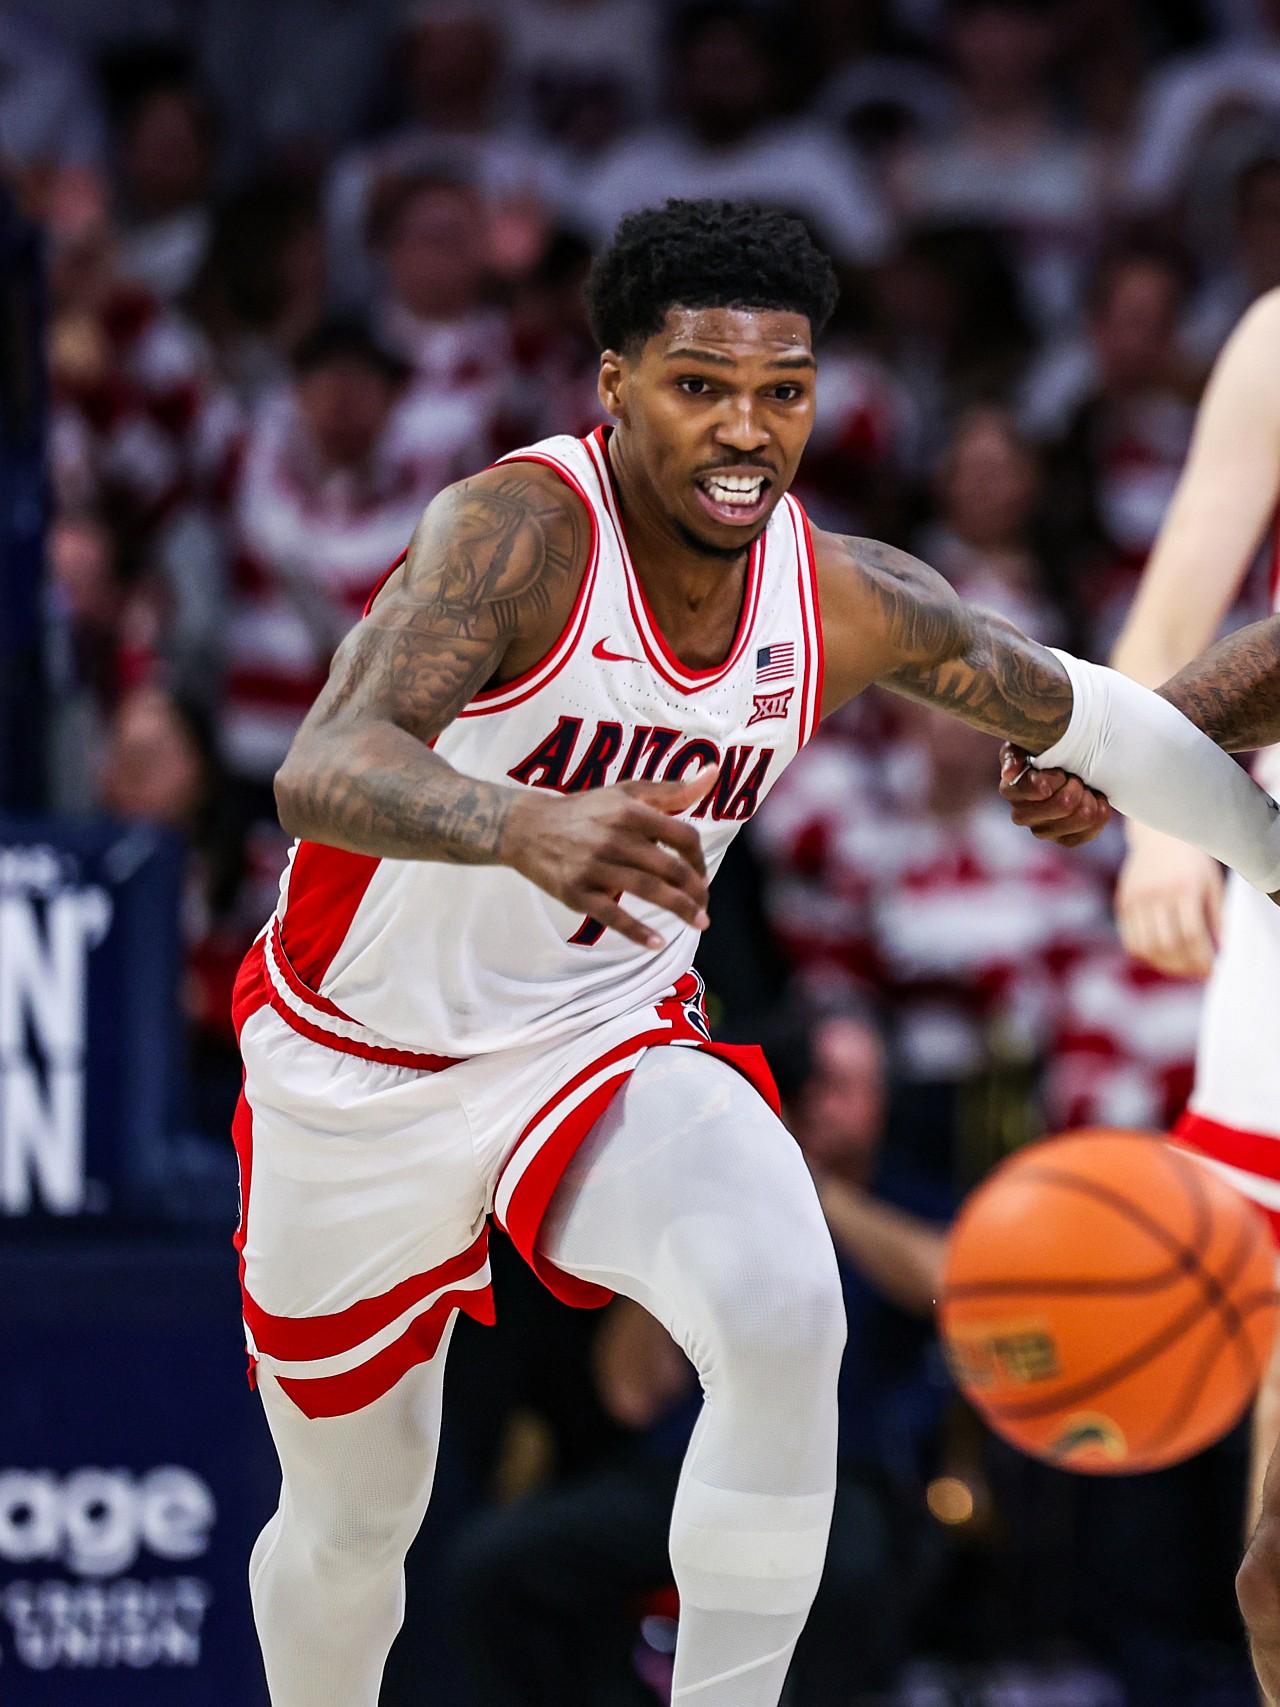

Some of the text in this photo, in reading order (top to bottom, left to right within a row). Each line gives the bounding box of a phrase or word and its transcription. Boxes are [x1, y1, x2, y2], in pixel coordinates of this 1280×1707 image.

[750, 692, 792, 723] XII
[508, 715, 773, 821] ARIZONA
[0, 1465, 215, 1577] age
